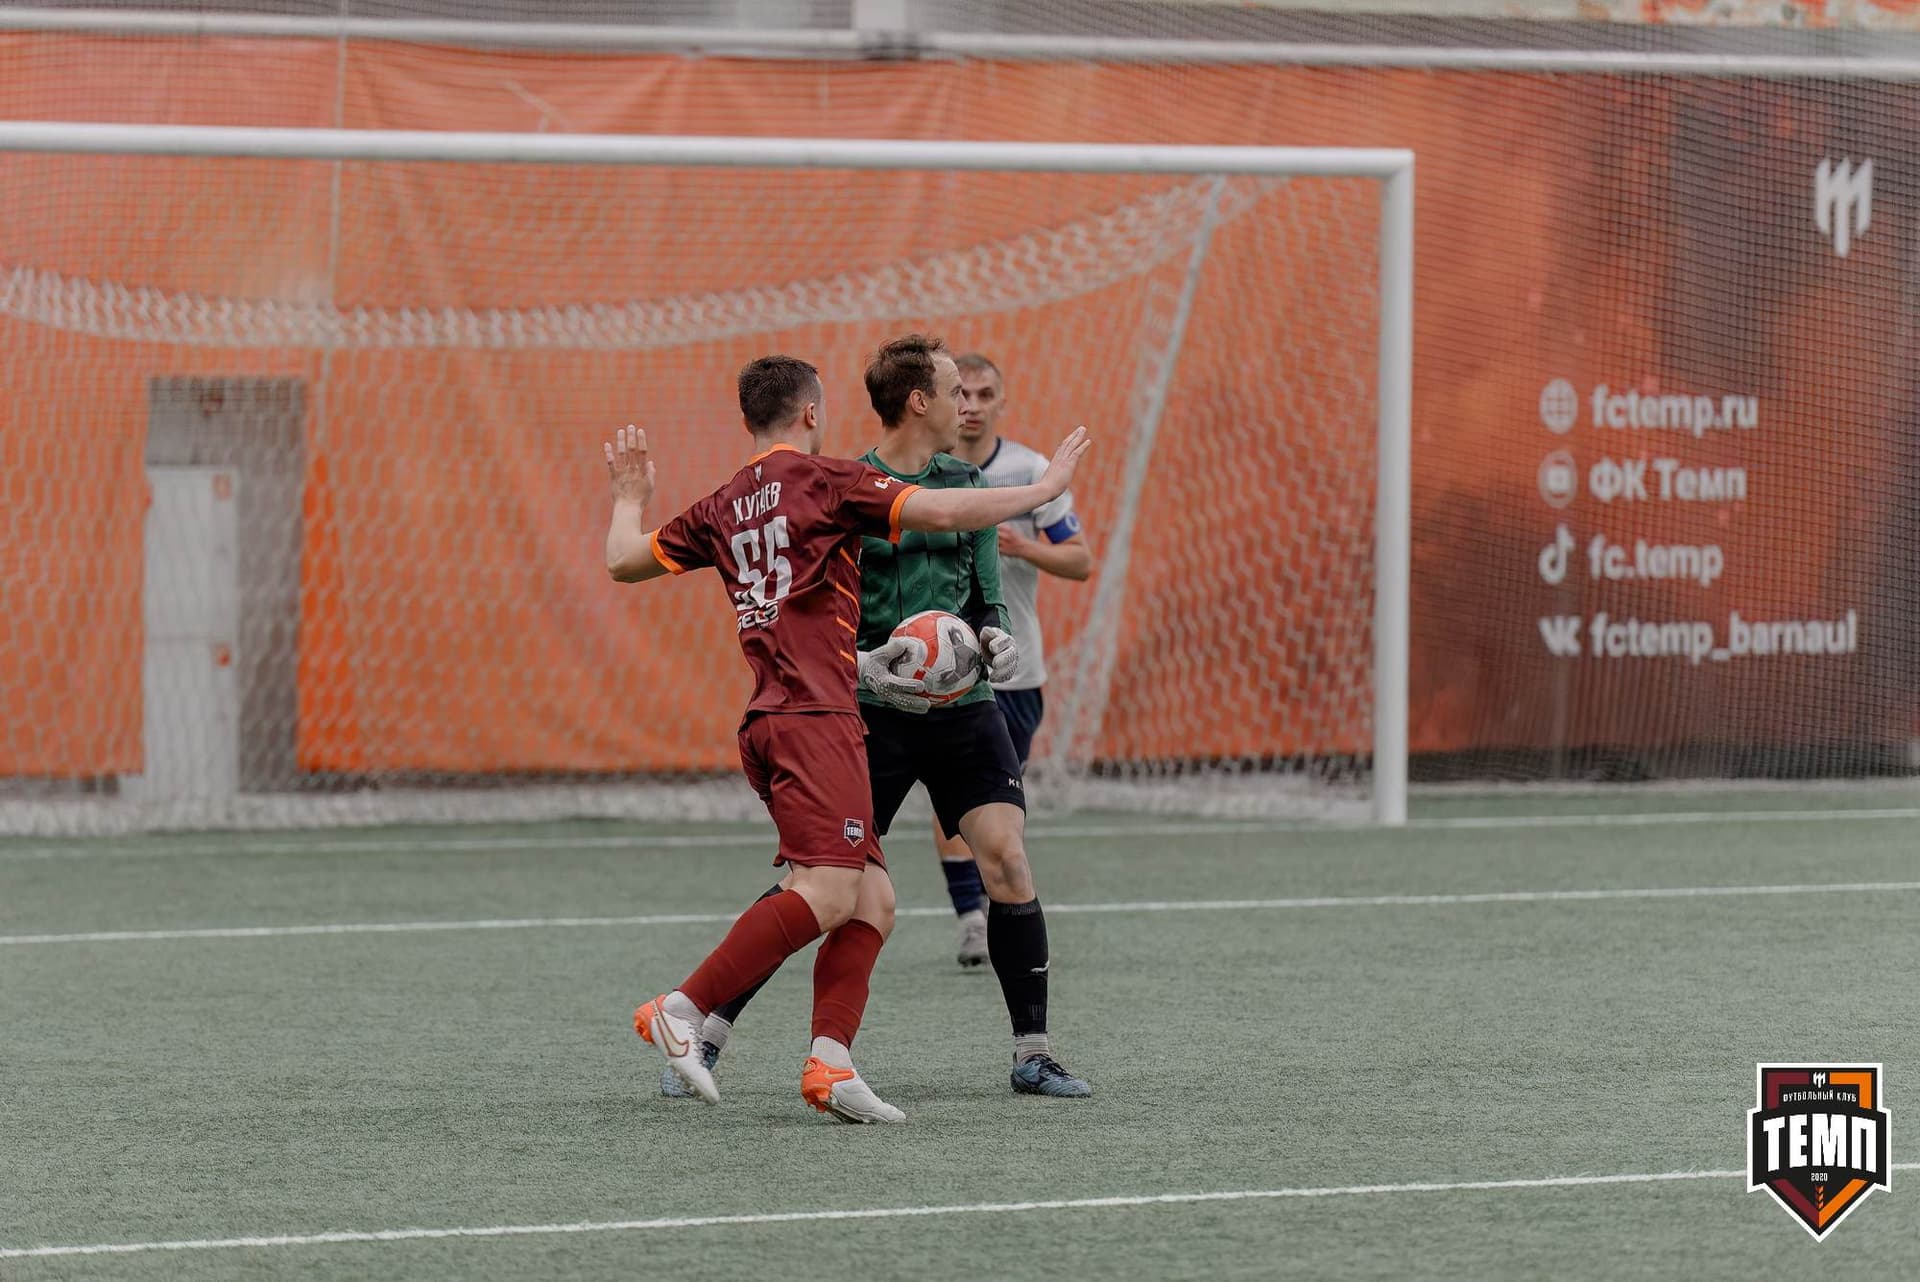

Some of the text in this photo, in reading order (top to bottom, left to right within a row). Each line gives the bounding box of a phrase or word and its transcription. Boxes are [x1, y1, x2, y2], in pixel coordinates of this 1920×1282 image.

[1592, 384, 1758, 438] fctemp.ru
[1589, 459, 1747, 502] ФК Темп
[731, 516, 793, 611] 56
[1588, 534, 1724, 588] fc.temp
[1590, 609, 1857, 665] fctemp_barnaul
